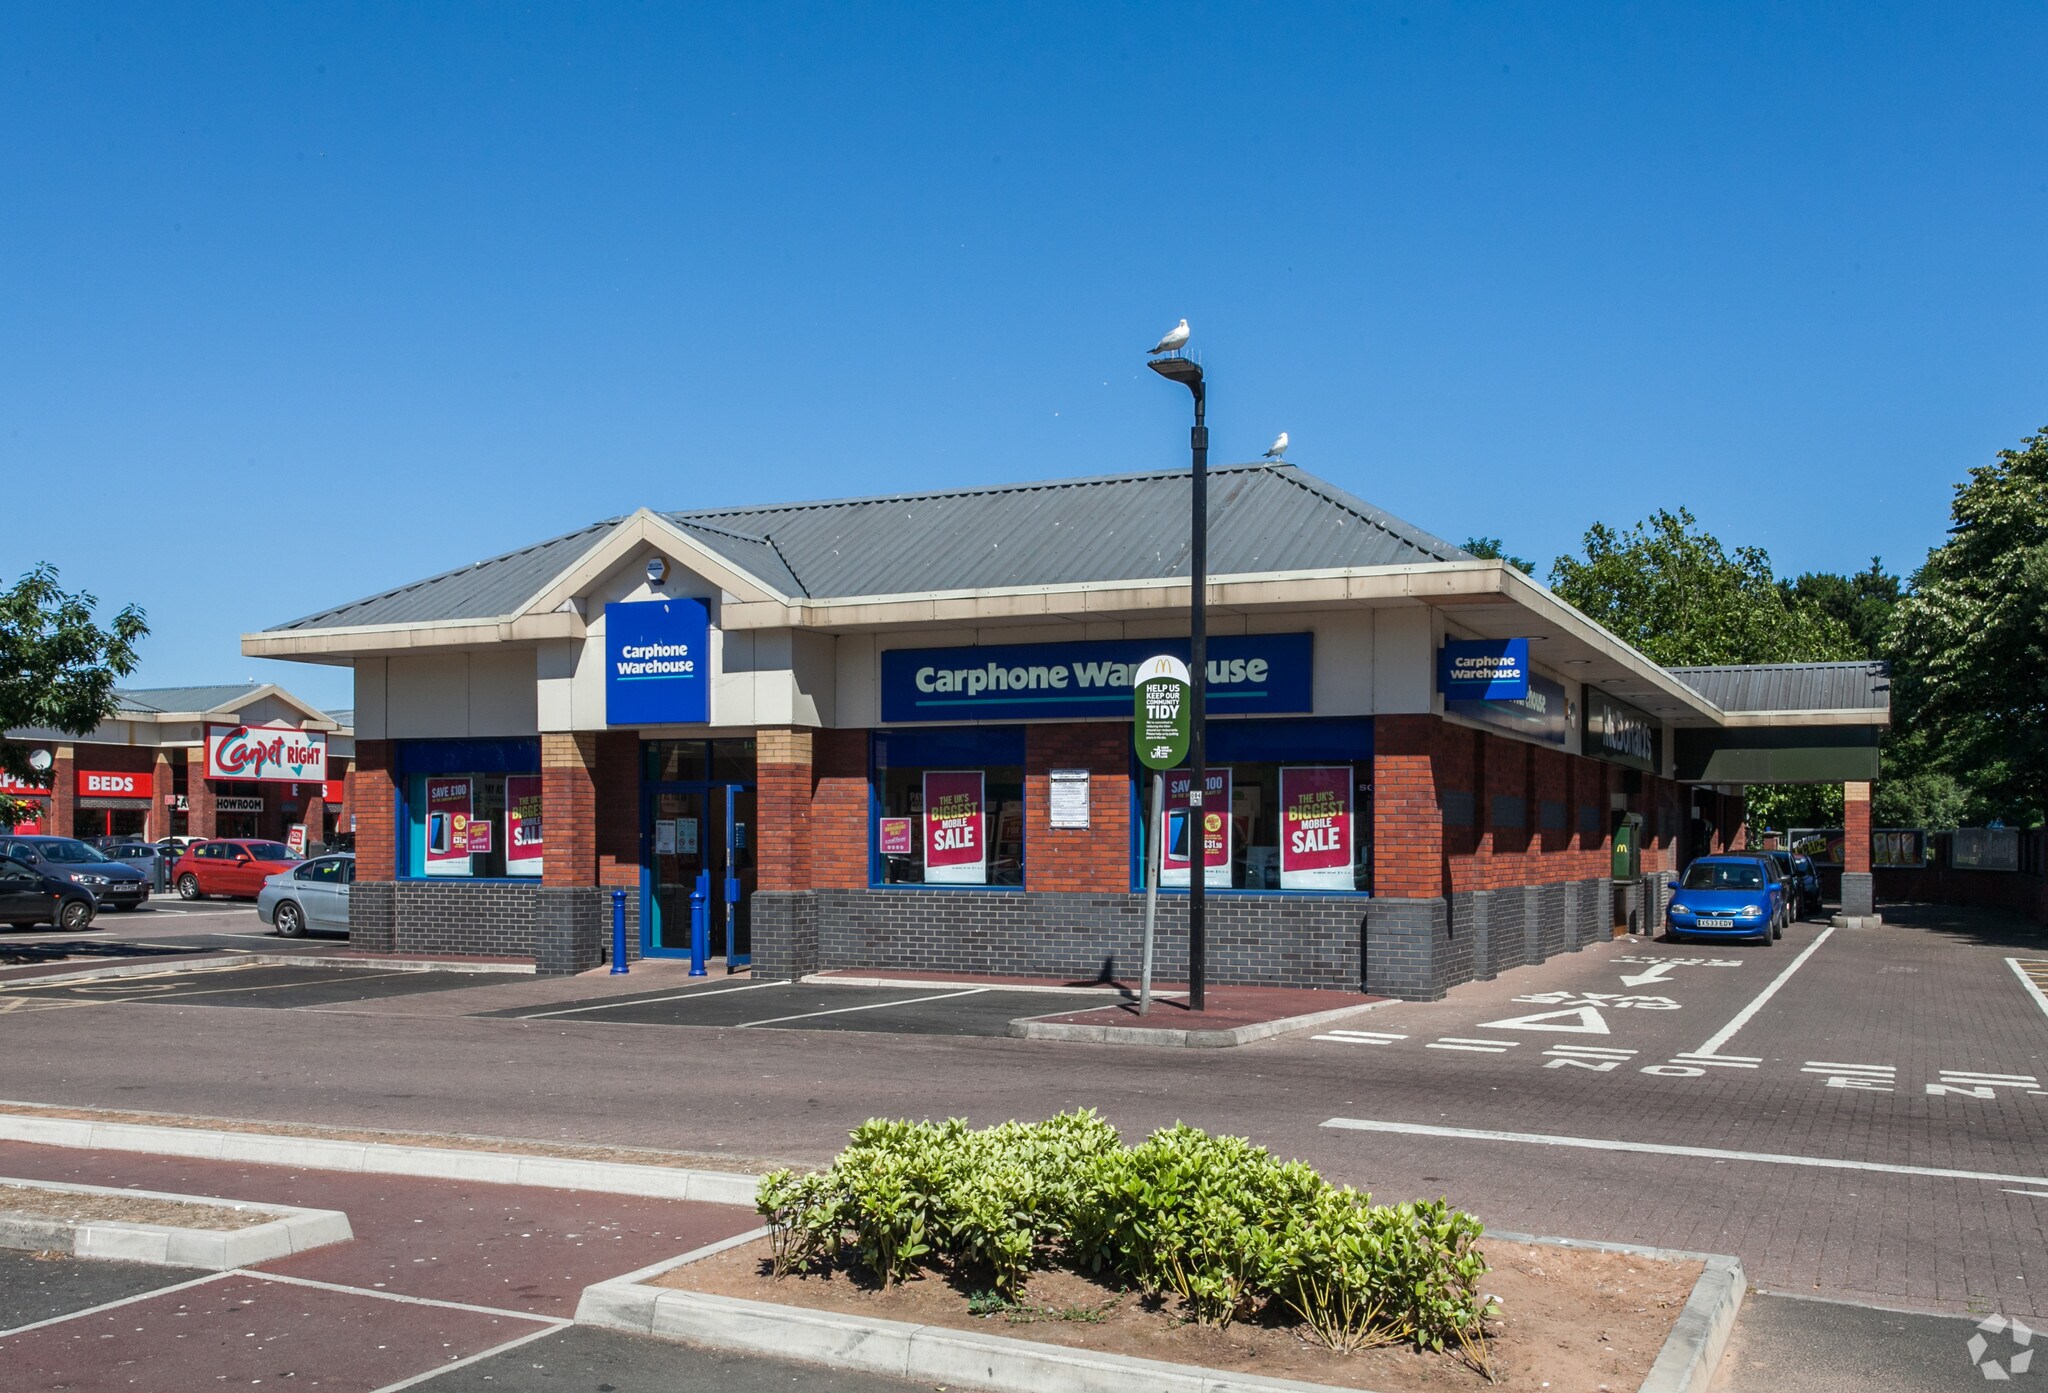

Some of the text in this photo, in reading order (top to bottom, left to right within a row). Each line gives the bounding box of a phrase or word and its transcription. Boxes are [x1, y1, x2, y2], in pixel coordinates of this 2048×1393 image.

[622, 643, 688, 660] Carphone
[616, 660, 694, 675] Warehouse
[1454, 656, 1516, 669] Carphone
[915, 657, 1269, 696] Carphone Waruse
[1450, 668, 1521, 680] Warehouse
[1146, 684, 1180, 693] HELP US
[1146, 692, 1180, 700] KEEP OUR
[1146, 705, 1180, 719] TIDY
[215, 726, 321, 777] Carpet RIGHT
[88, 775, 134, 792] BEDS
[1171, 776, 1223, 794] SAV 100
[432, 784, 467, 799] SAVE £100
[939, 793, 970, 805] THE UK'S
[1298, 791, 1335, 804] THE UK'S
[216, 798, 262, 810] HOWROOM
[519, 796, 530, 805] THE
[931, 801, 978, 821] BIGGEST
[1288, 800, 1345, 821] BIGGEST
[942, 818, 968, 830] MOBILE
[1301, 817, 1333, 830] MOBILE
[934, 826, 975, 851] SALE
[1291, 826, 1341, 854] SALE
[1542, 1058, 1707, 1078] NO
